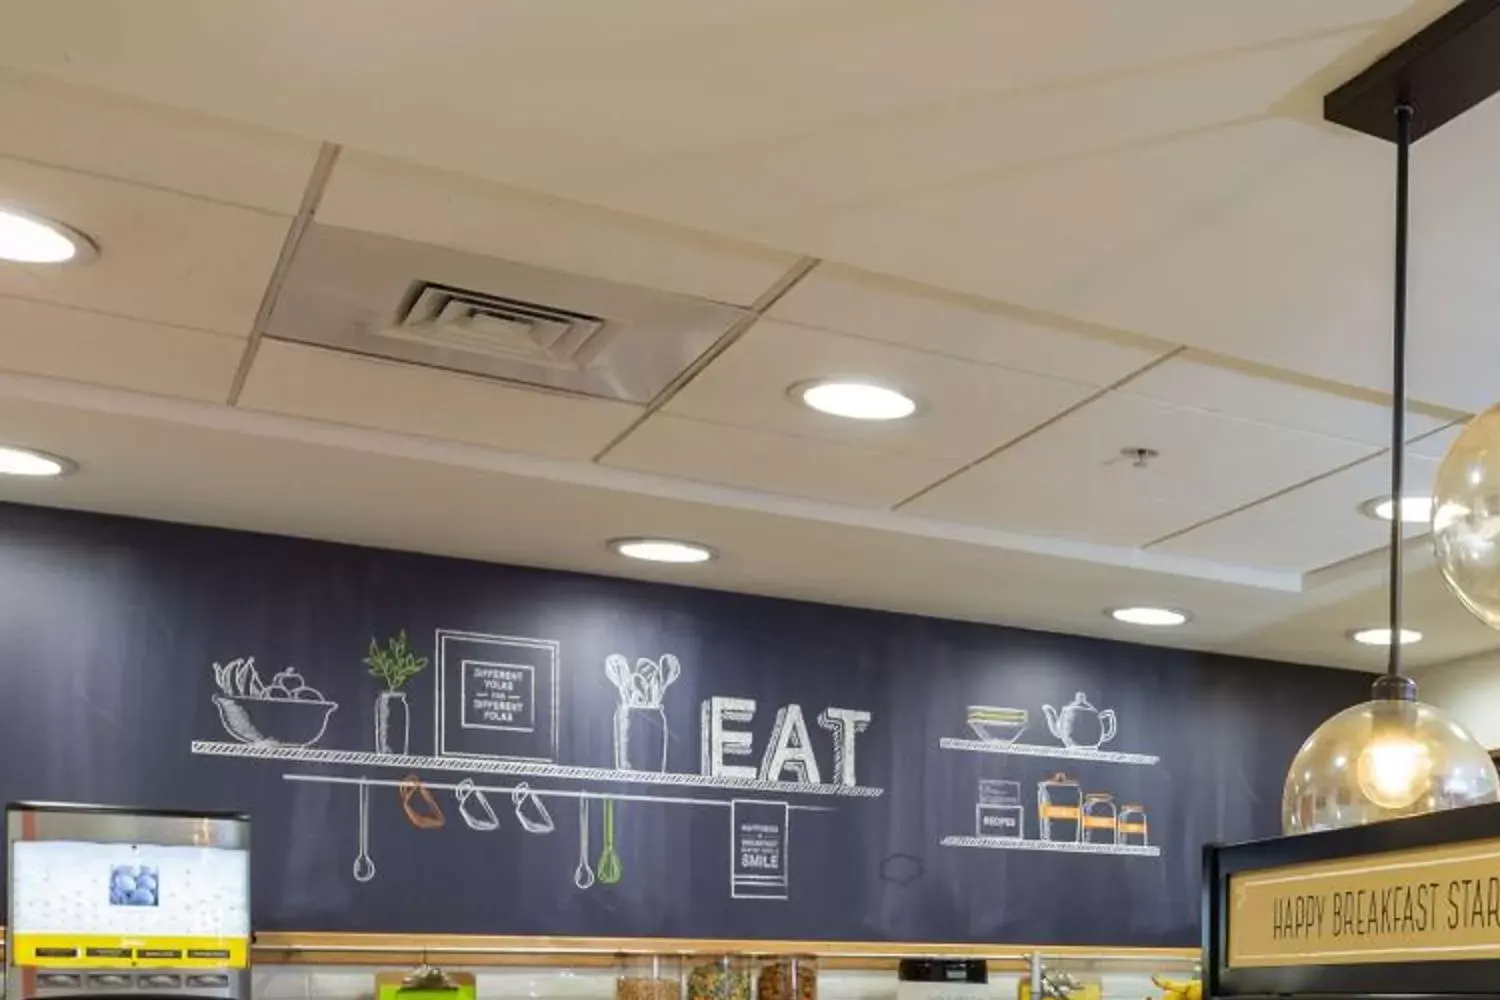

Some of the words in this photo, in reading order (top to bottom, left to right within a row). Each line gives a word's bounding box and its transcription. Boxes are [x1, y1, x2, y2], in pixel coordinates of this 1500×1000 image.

[701, 696, 871, 787] EAT
[742, 854, 779, 868] SMILE
[1273, 895, 1326, 940] HAPPY
[1332, 882, 1439, 937] BREAKFAST
